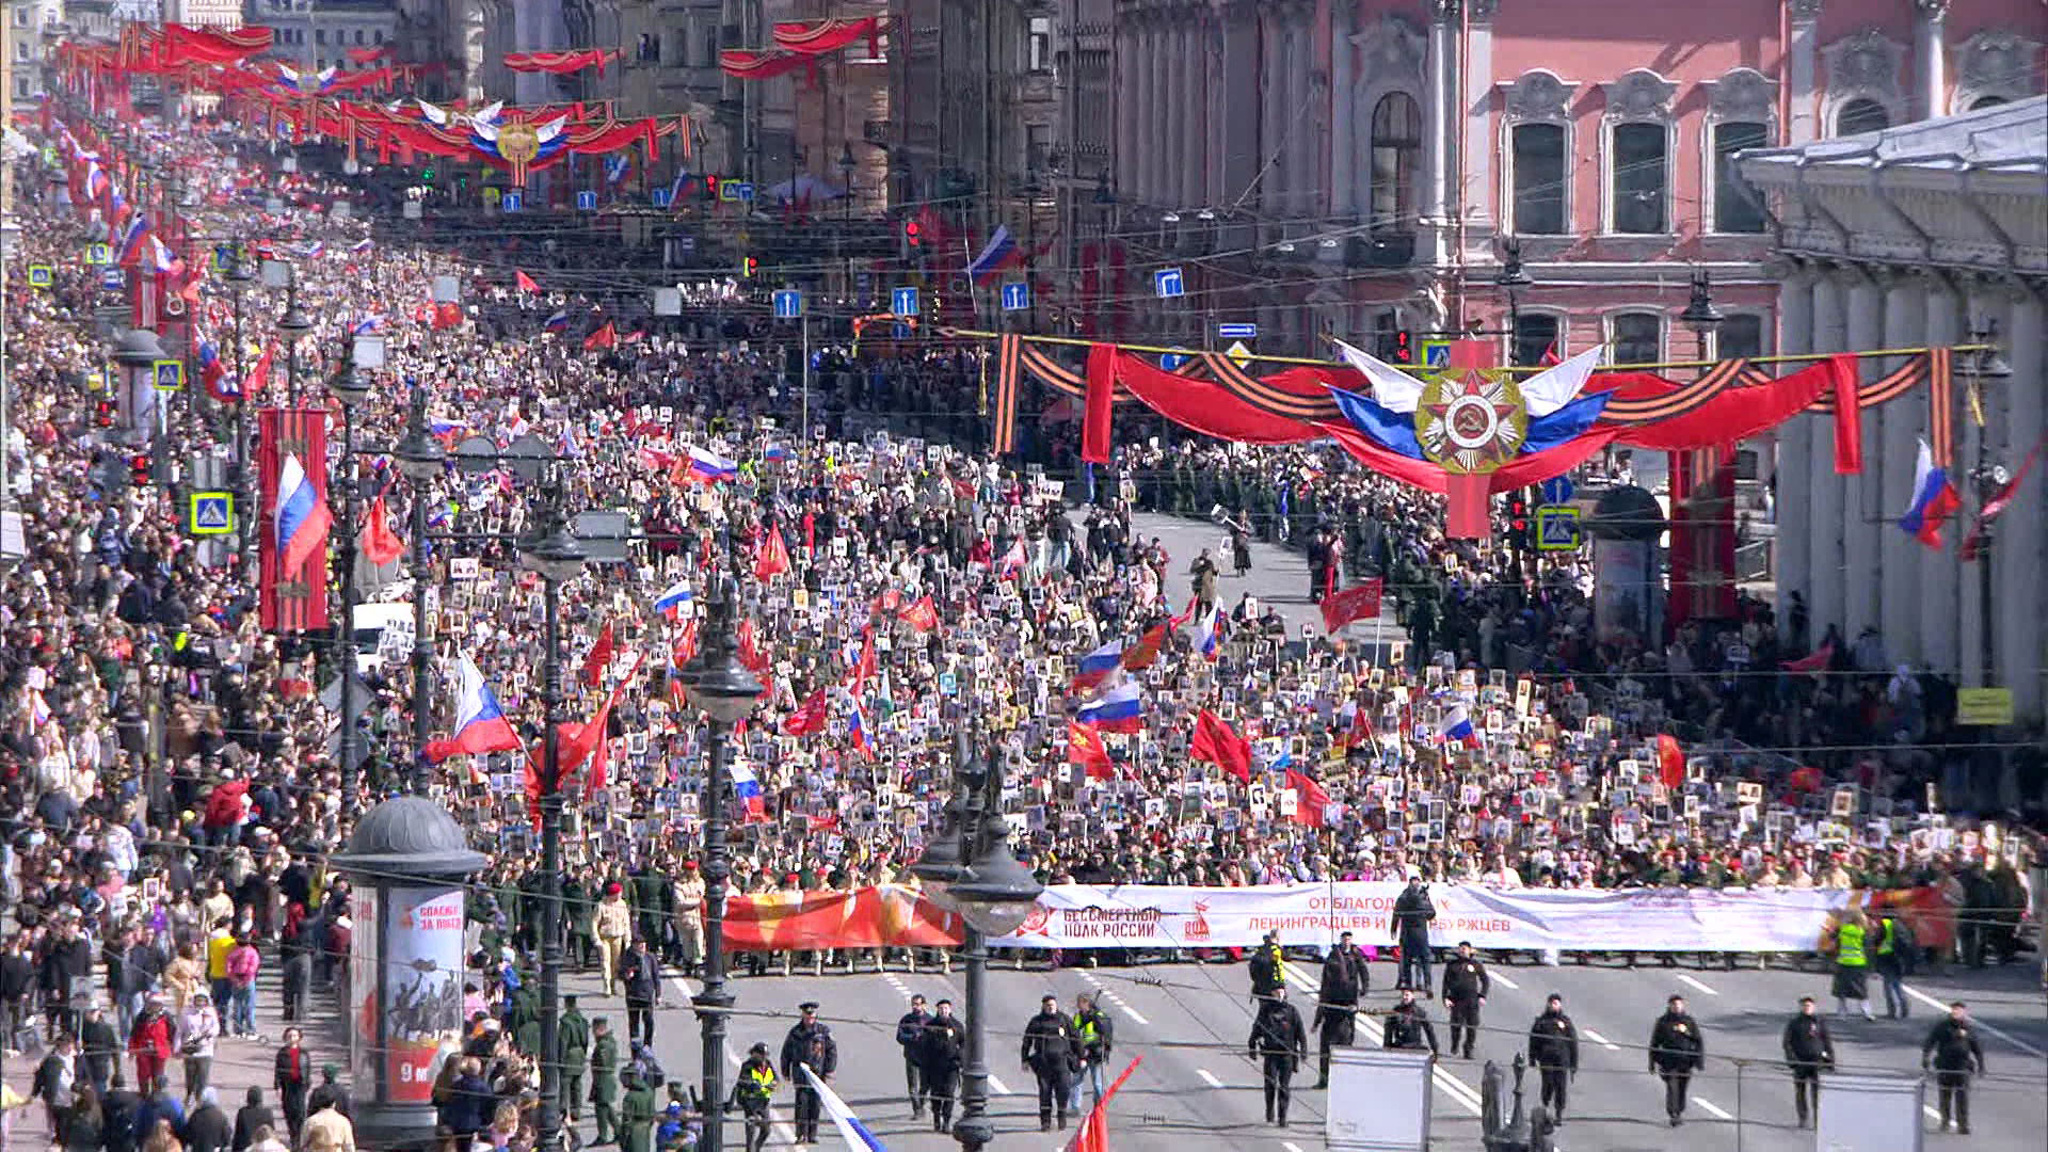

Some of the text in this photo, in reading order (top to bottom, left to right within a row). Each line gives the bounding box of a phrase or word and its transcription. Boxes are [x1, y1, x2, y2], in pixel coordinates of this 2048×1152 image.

[1309, 897, 1329, 909] ОТ
[1063, 922, 1156, 937] ПОЛК РОССИИ
[1249, 916, 1371, 930] ЛЕНИНГРАДЦЕВ
[1419, 918, 1511, 932] РБУРЖЦЕВ
[401, 1062, 412, 1083] 9
